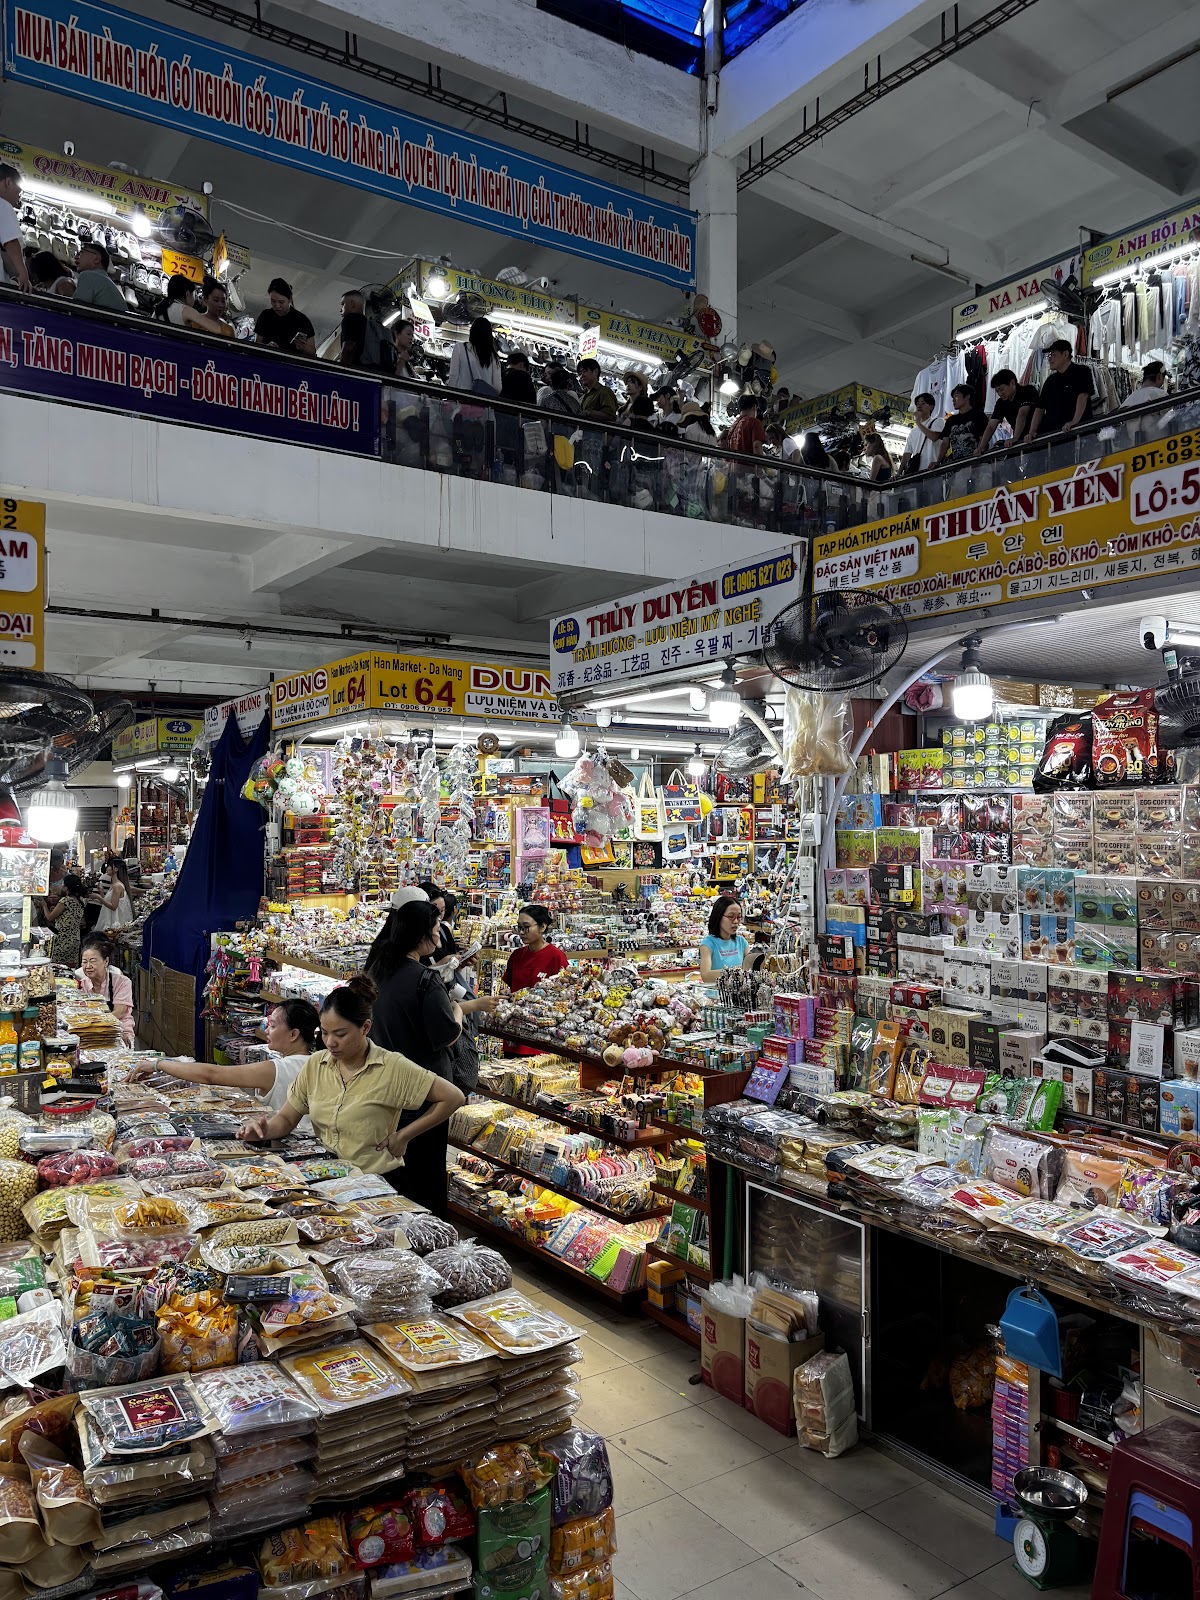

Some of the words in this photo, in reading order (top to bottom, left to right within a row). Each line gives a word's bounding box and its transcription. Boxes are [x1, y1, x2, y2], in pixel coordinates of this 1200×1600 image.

[15, 7, 54, 66] MUA
[56, 15, 90, 79] BÁN
[91, 26, 134, 93] HÀNG
[136, 43, 169, 104] HÓA
[170, 55, 193, 112] CÓ
[194, 62, 243, 128] NGUỒN
[245, 75, 273, 137] GỐC
[274, 88, 309, 149] XUẤT
[310, 102, 330, 156] XỨ
[331, 109, 350, 163] RÕ
[351, 114, 384, 175] RÀNG
[385, 126, 402, 180] LÀ
[403, 134, 442, 193] QUYỀN
[442, 152, 462, 207] LỢI
[463, 153, 479, 205] VÀ
[480, 165, 513, 216] NGHĨA
[513, 178, 530, 230] VỤ
[531, 176, 553, 229] CỦA
[553, 192, 593, 241] THƯƠNG
[594, 202, 620, 249] NHÂN
[620, 208, 635, 254] VÀ
[635, 216, 666, 264] KHÁCH
[667, 223, 691, 272] HÀNG
[33, 155, 118, 190] QUỲNH
[120, 180, 171, 205] ANH
[1116, 239, 1147, 258] ÁNH
[171, 261, 197, 278] 257
[989, 291, 1012, 313] NA
[1016, 278, 1041, 302] NA
[23, 326, 73, 375] TĂNG
[77, 342, 126, 386] MINH
[130, 353, 178, 398] BẠCH
[192, 360, 238, 408] ĐỒNG
[241, 375, 285, 417] HÀNH
[288, 381, 320, 424] BỀN
[322, 391, 349, 430] LÂU
[1131, 450, 1164, 473] ĐT:
[925, 488, 1038, 544] THUẬN
[1044, 461, 1124, 515] YẾN
[817, 540, 836, 556] TẠP
[838, 533, 859, 550] HÓA
[861, 526, 889, 544] THỰC
[889, 514, 920, 536] PHẨM
[816, 560, 838, 578] ĐẶC
[839, 554, 861, 572] SẢN
[863, 549, 886, 567] VIỆT
[890, 543, 915, 558] NAM
[1070, 541, 1098, 562] KHÔ
[723, 577, 736, 596] ĐT:
[736, 569, 757, 591] 0905
[758, 564, 774, 586] 627
[776, 558, 792, 582] 023
[642, 579, 718, 624] DUYÊN
[600, 634, 635, 657] HƯƠNG
[645, 625, 667, 647] LƯU
[669, 618, 698, 640] NIỆM
[700, 609, 720, 632] MỸ
[723, 598, 760, 628] NGHỆ
[373, 656, 391, 670] Han
[392, 659, 421, 675] Market
[429, 663, 440, 675] Da
[442, 664, 463, 681] Nang
[620, 652, 650, 675] 工艺品
[276, 669, 329, 704] DUNG
[332, 687, 345, 705] Lot
[347, 674, 366, 704] 64
[379, 680, 408, 699] Lot
[414, 677, 456, 708] 64
[470, 666, 551, 697] DUN
[467, 694, 494, 706] LƯU
[498, 696, 527, 711] NIỆM
[530, 700, 547, 712] VÀ
[484, 707, 539, 718] SOUVENIR
[816, 1007, 836, 1016] Colgate
[816, 1018, 836, 1027] Colgate
[805, 1039, 824, 1049] Colgate
[816, 1028, 835, 1036] Colgate
[806, 1050, 824, 1059] Colgate
